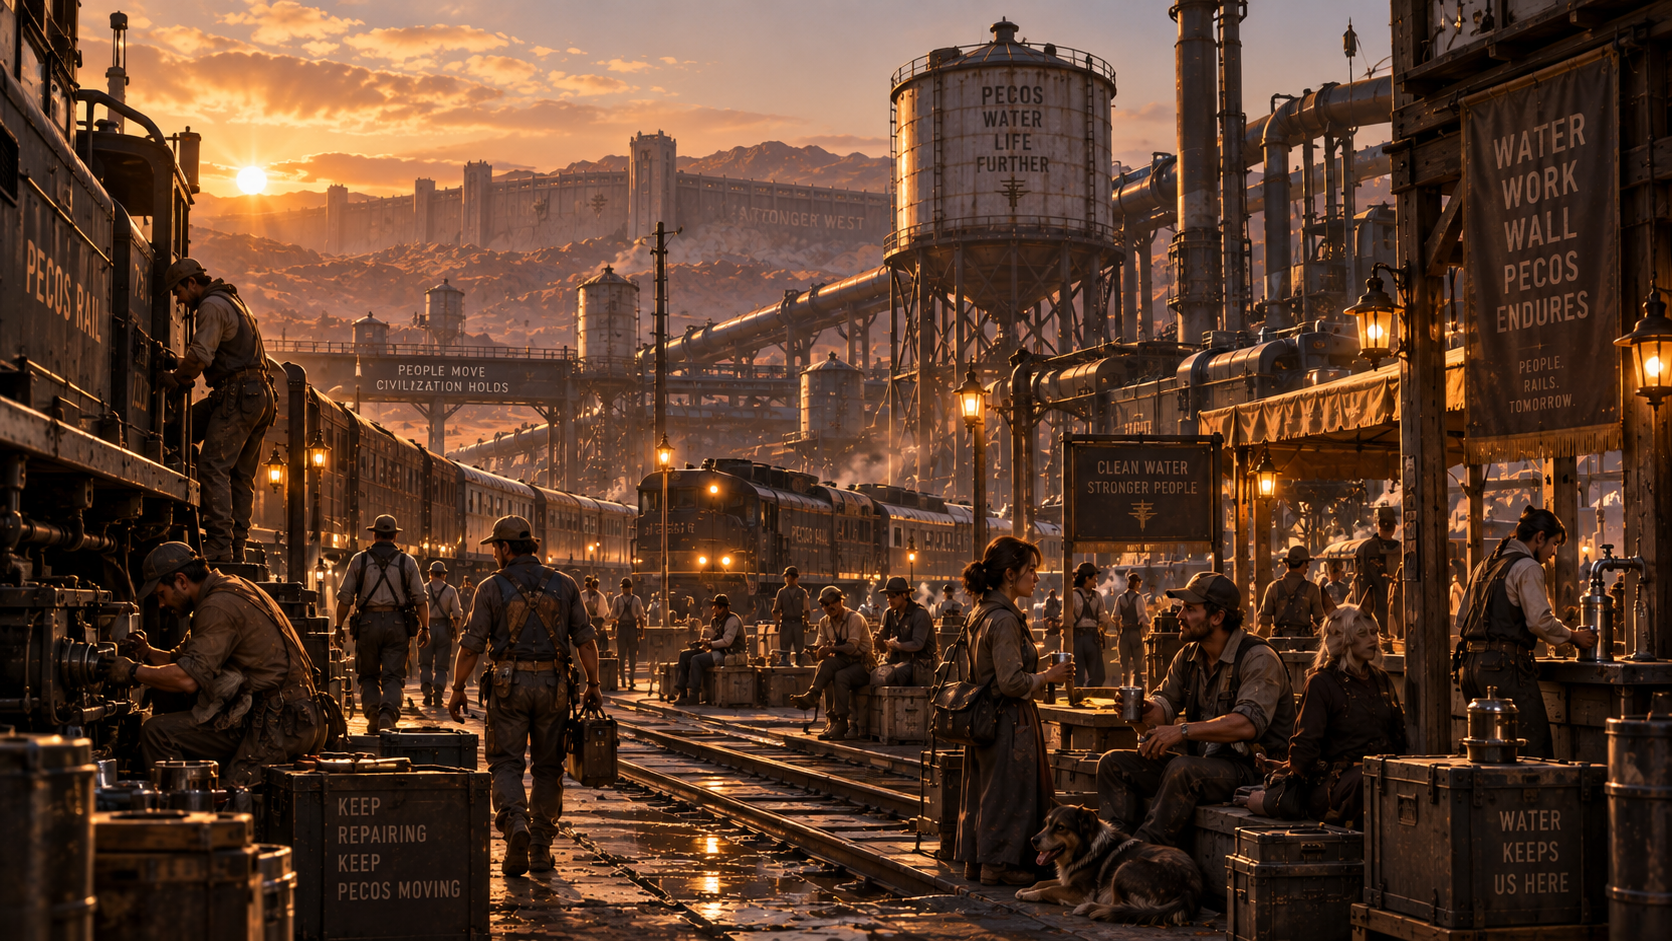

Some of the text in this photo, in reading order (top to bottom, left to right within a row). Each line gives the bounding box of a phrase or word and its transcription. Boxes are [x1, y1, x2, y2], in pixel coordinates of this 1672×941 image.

[982, 85, 1043, 105] PECOS
[983, 110, 1042, 128] WATER
[994, 133, 1032, 151] LIFE
[1494, 112, 1586, 170] WATER
[976, 156, 1049, 173] FURTHER
[1502, 159, 1579, 210] WORK
[824, 214, 865, 230] WEST
[1504, 206, 1578, 253] WALL
[1504, 250, 1579, 295] PECOS
[26, 239, 101, 344] PECOS RAIL
[1496, 290, 1589, 334] ENDURES
[398, 365, 485, 377] PEOPLE MOVE
[1518, 355, 1564, 374] PEOPLE.
[376, 380, 509, 393] CIVILIZATION HOLDS
[1524, 376, 1560, 393] RAILS.
[1509, 393, 1576, 414] TOMORROW.
[1097, 459, 1188, 475] CLEAN WATER
[1087, 480, 1198, 495] STRONGER PEOPLE
[337, 797, 381, 816] KEEP
[1499, 810, 1561, 831] WATER
[338, 824, 427, 844] REPAIRING
[1502, 840, 1560, 863] KEEPS
[337, 853, 381, 872] KEEP
[337, 879, 461, 901] PECOS MOVING
[1494, 872, 1569, 894] US HERE
